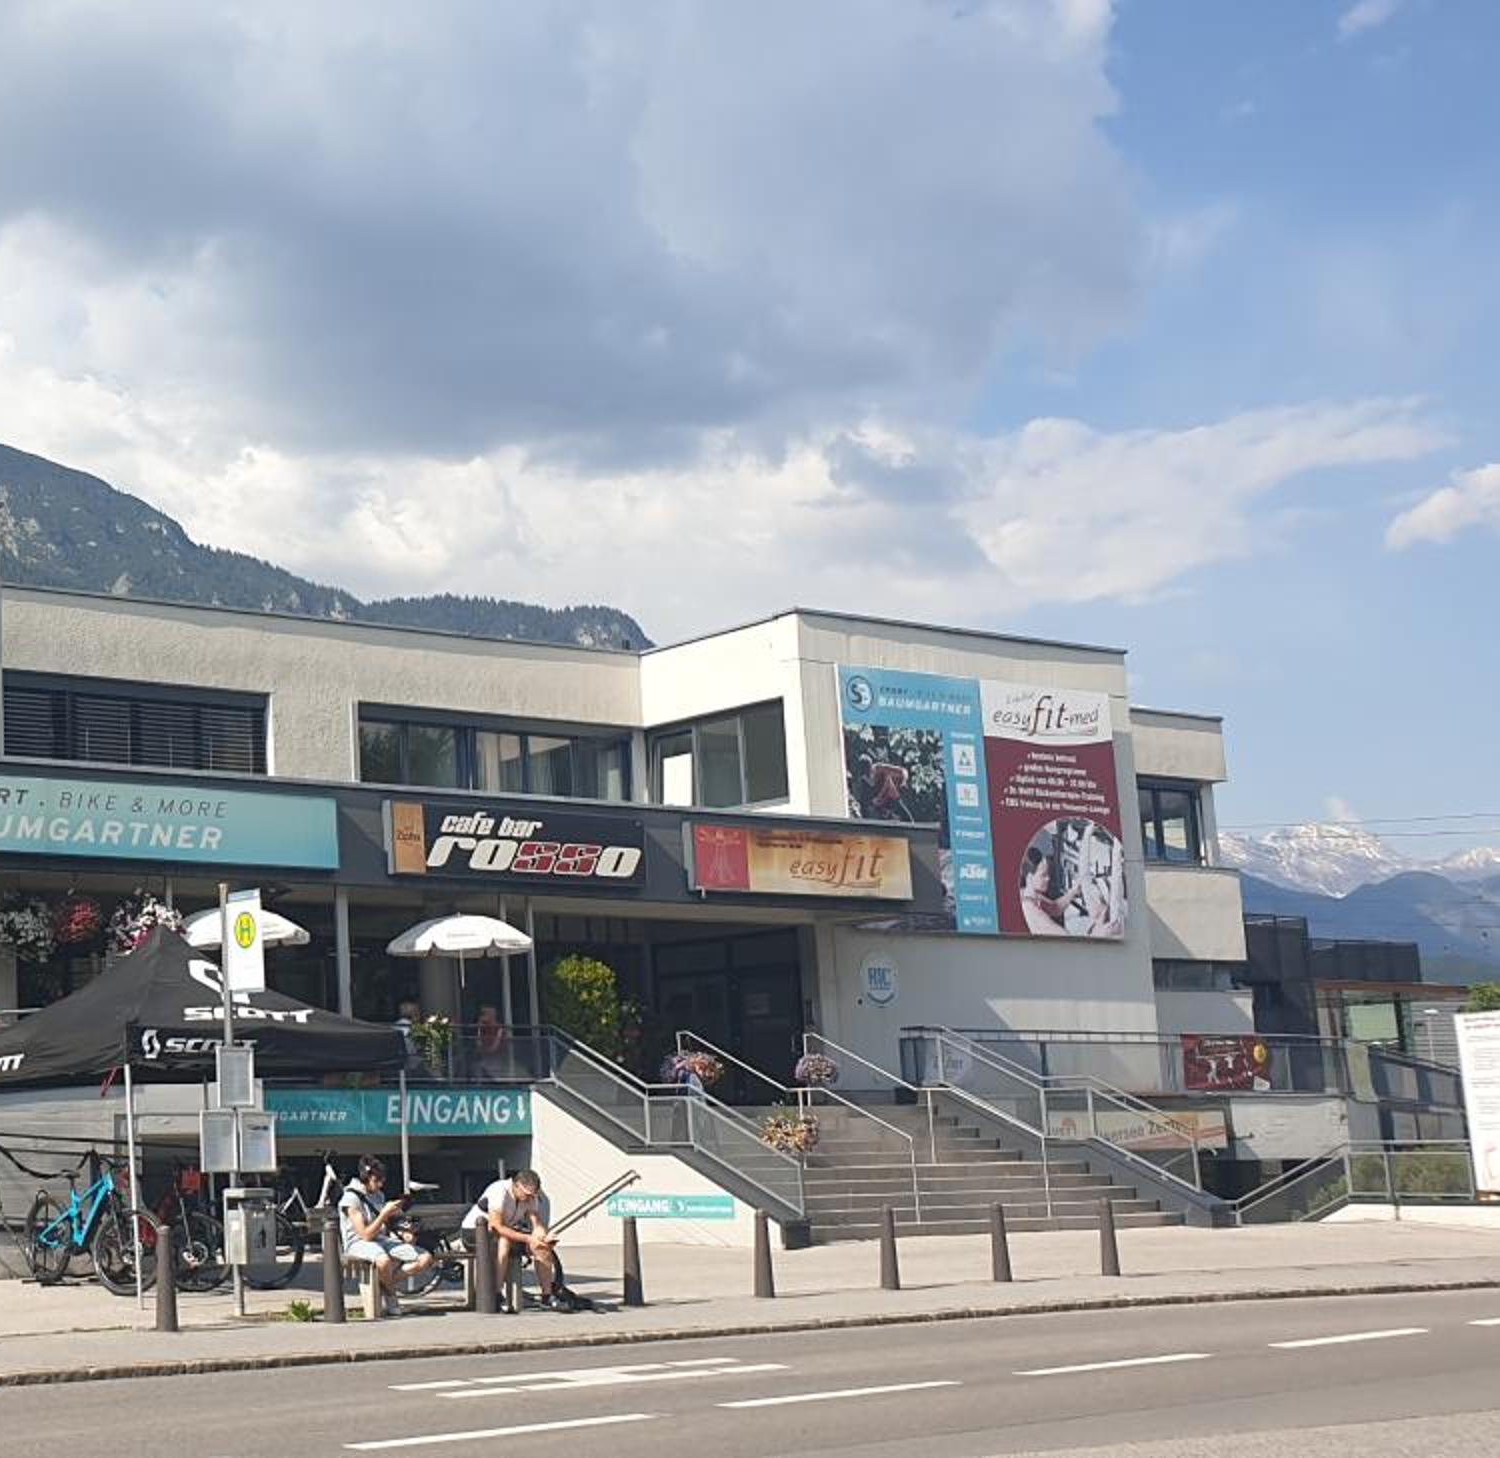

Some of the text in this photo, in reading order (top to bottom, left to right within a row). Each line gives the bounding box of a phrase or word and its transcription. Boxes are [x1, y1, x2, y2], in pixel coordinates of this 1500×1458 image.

[877, 697, 972, 715] BAUMGARTNER
[59, 791, 117, 812] BIKE
[131, 798, 144, 814] &
[157, 799, 229, 818] MORE
[439, 811, 543, 838] cafe bar
[425, 835, 642, 878] rosso
[183, 1006, 315, 1023] SCOTT
[164, 1037, 258, 1052] SCOT
[273, 1111, 348, 1121] GARTNER
[387, 1095, 510, 1124] EINGANG
